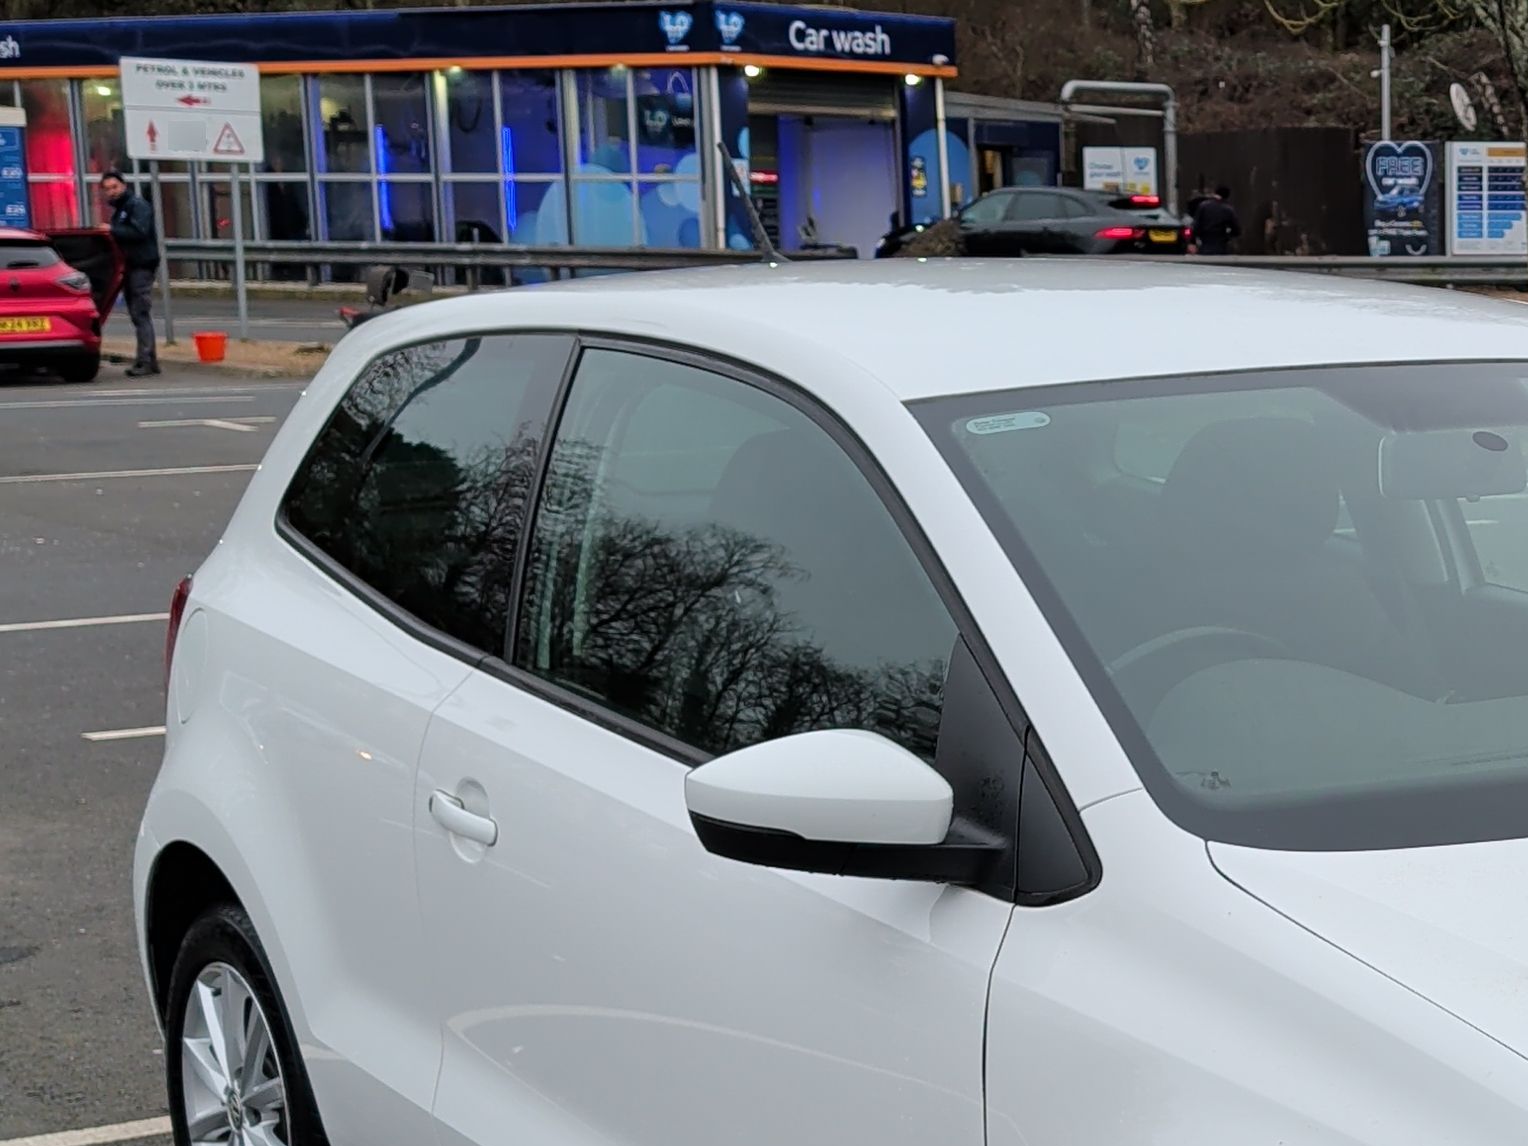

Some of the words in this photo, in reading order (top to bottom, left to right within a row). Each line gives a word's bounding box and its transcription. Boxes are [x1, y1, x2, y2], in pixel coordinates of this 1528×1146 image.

[789, 20, 829, 51] Car
[831, 24, 891, 55] wash
[136, 63, 178, 76] PETROL
[192, 67, 245, 78] VEHICLES
[155, 80, 185, 90] OVER
